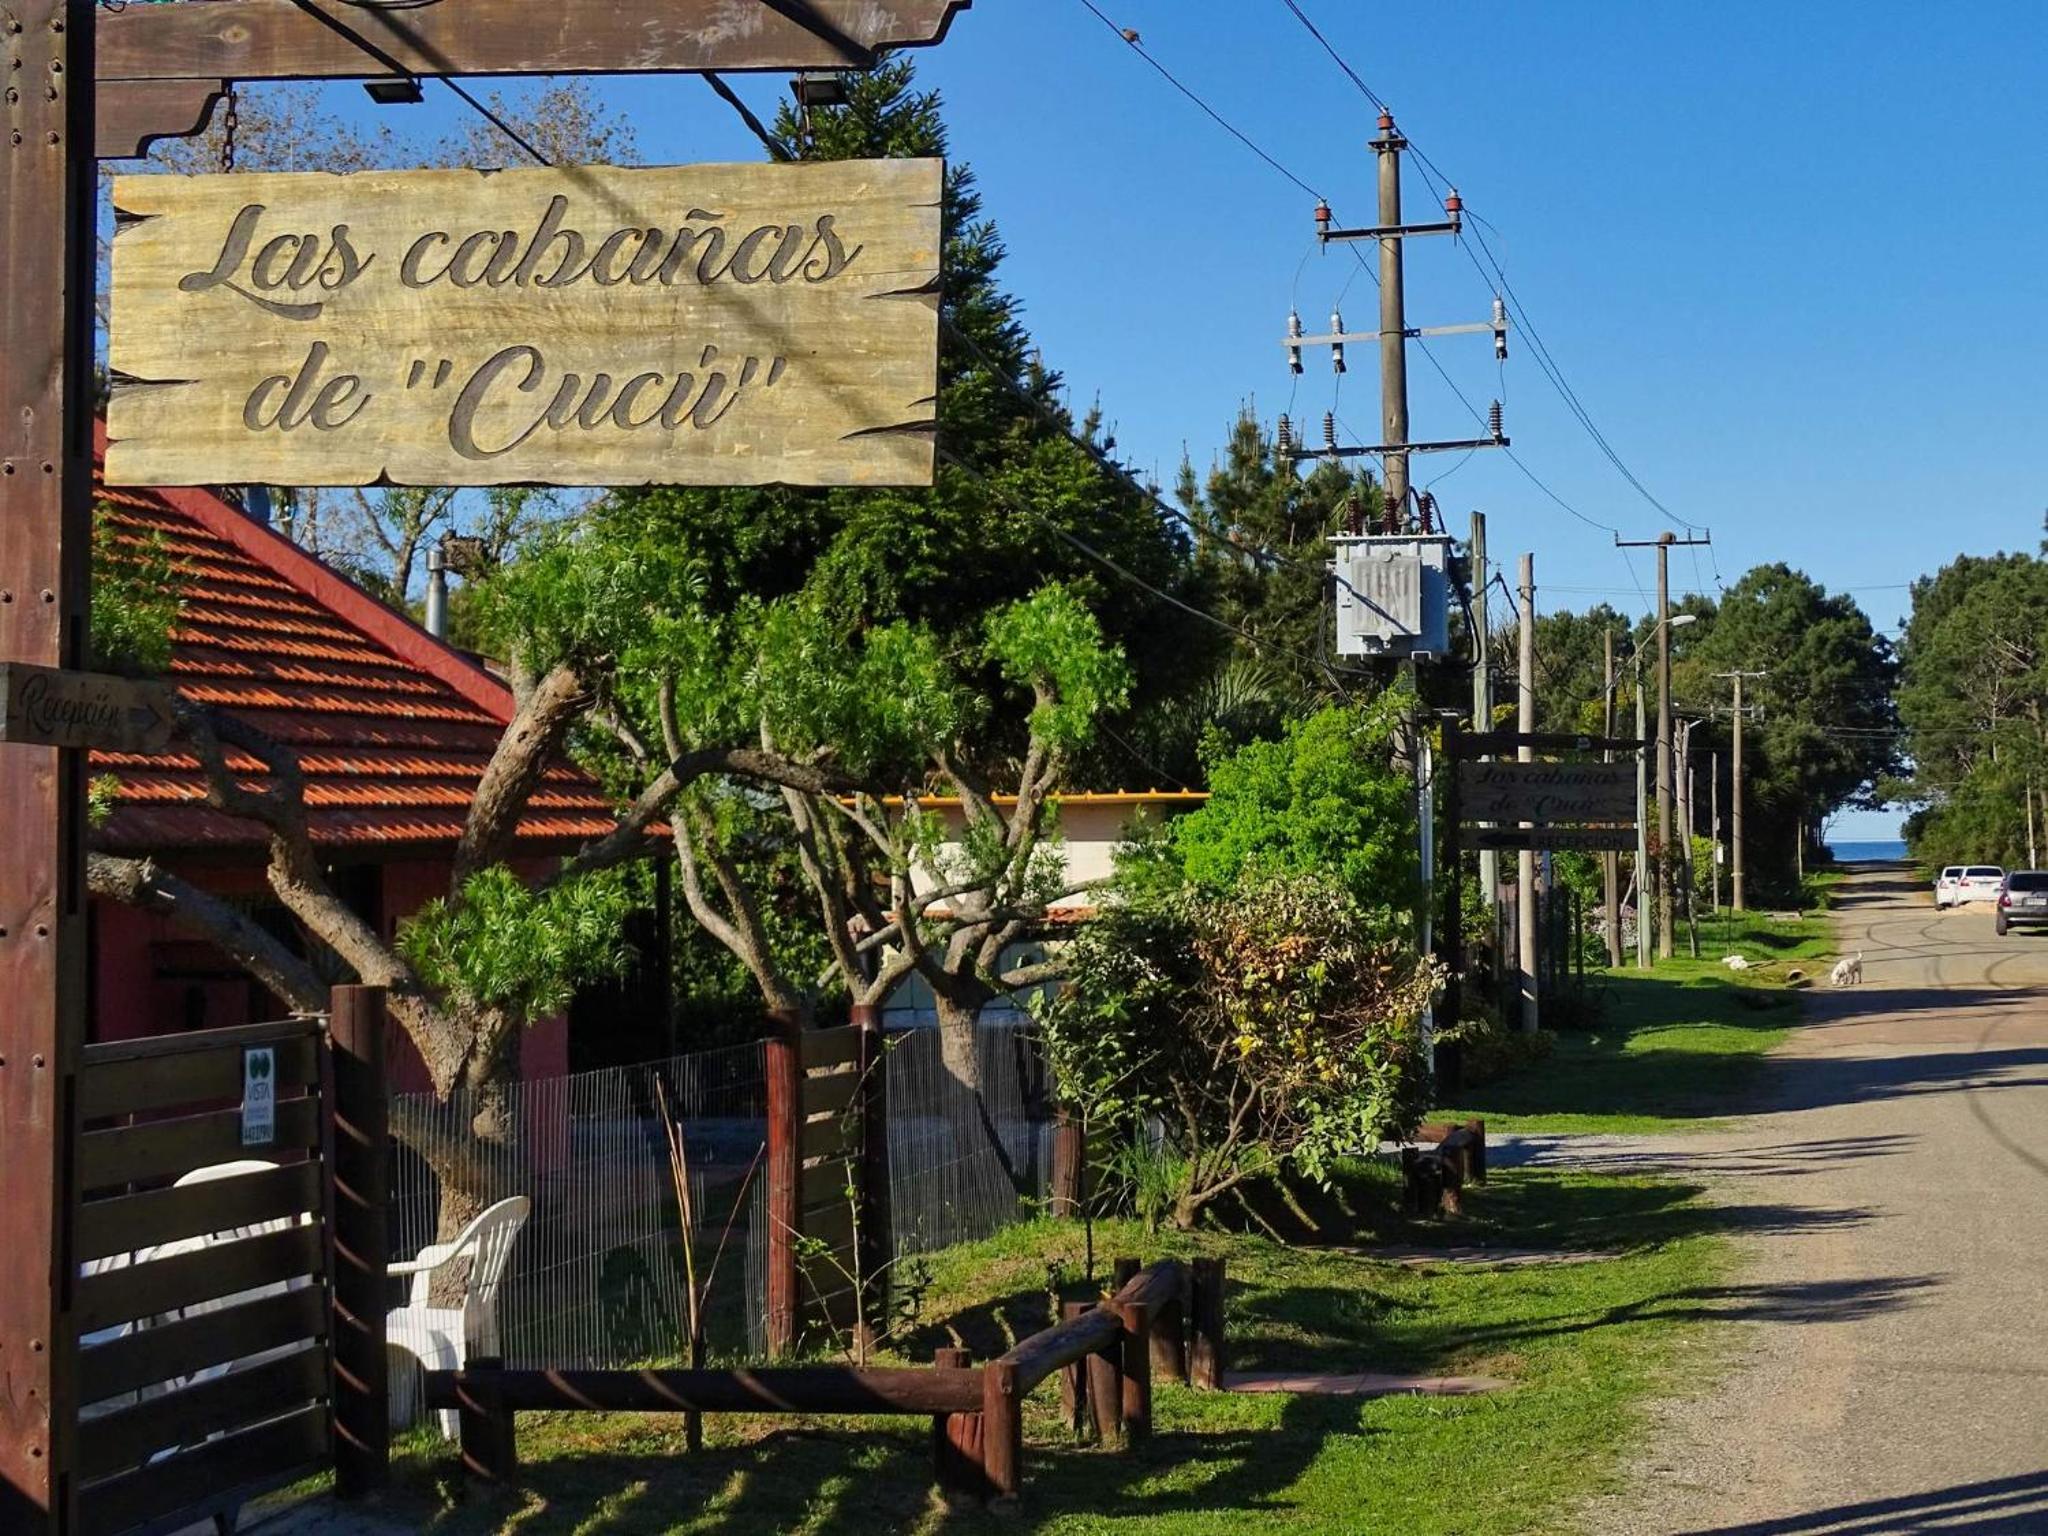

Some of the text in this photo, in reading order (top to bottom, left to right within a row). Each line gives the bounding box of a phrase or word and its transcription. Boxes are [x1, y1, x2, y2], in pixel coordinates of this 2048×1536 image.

[178, 195, 864, 321] Las cabañas
[242, 340, 788, 461] de "Cucú"
